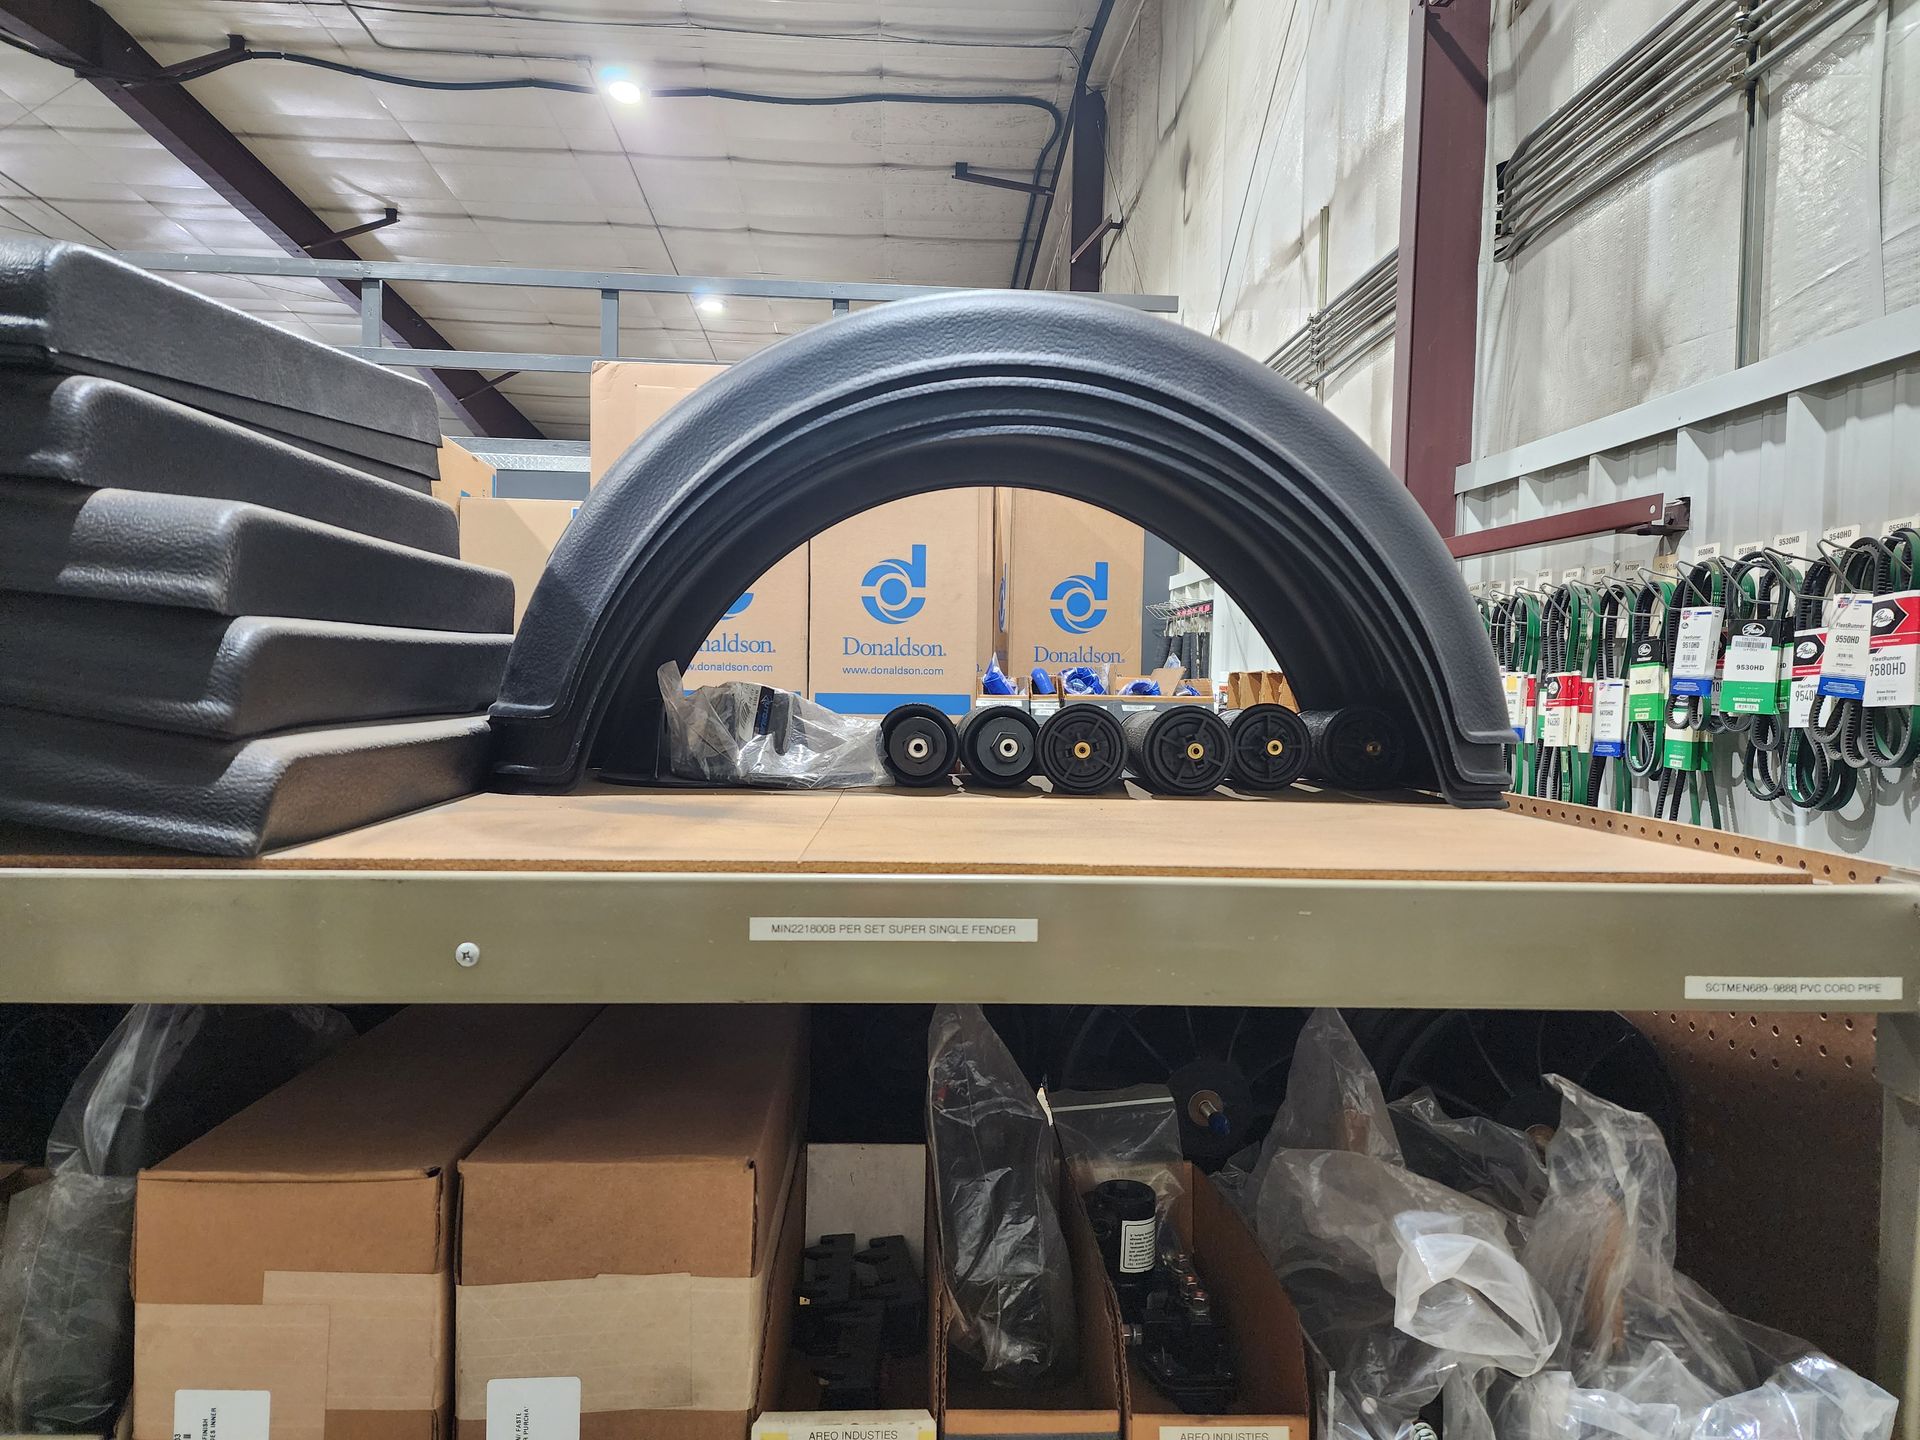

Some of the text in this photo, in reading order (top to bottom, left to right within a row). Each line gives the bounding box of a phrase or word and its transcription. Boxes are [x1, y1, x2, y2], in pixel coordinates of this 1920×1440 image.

[1835, 634, 1860, 644] 9550HD
[842, 666, 944, 677] www.donaldson.com
[1735, 663, 1765, 671] 9530HD
[1869, 661, 1906, 677] 9580HD
[771, 924, 1017, 936] MIN221800B PER SET SUPER SINGLE FENDER
[1799, 983, 1822, 993] PVC
[1857, 983, 1882, 993] PIPE
